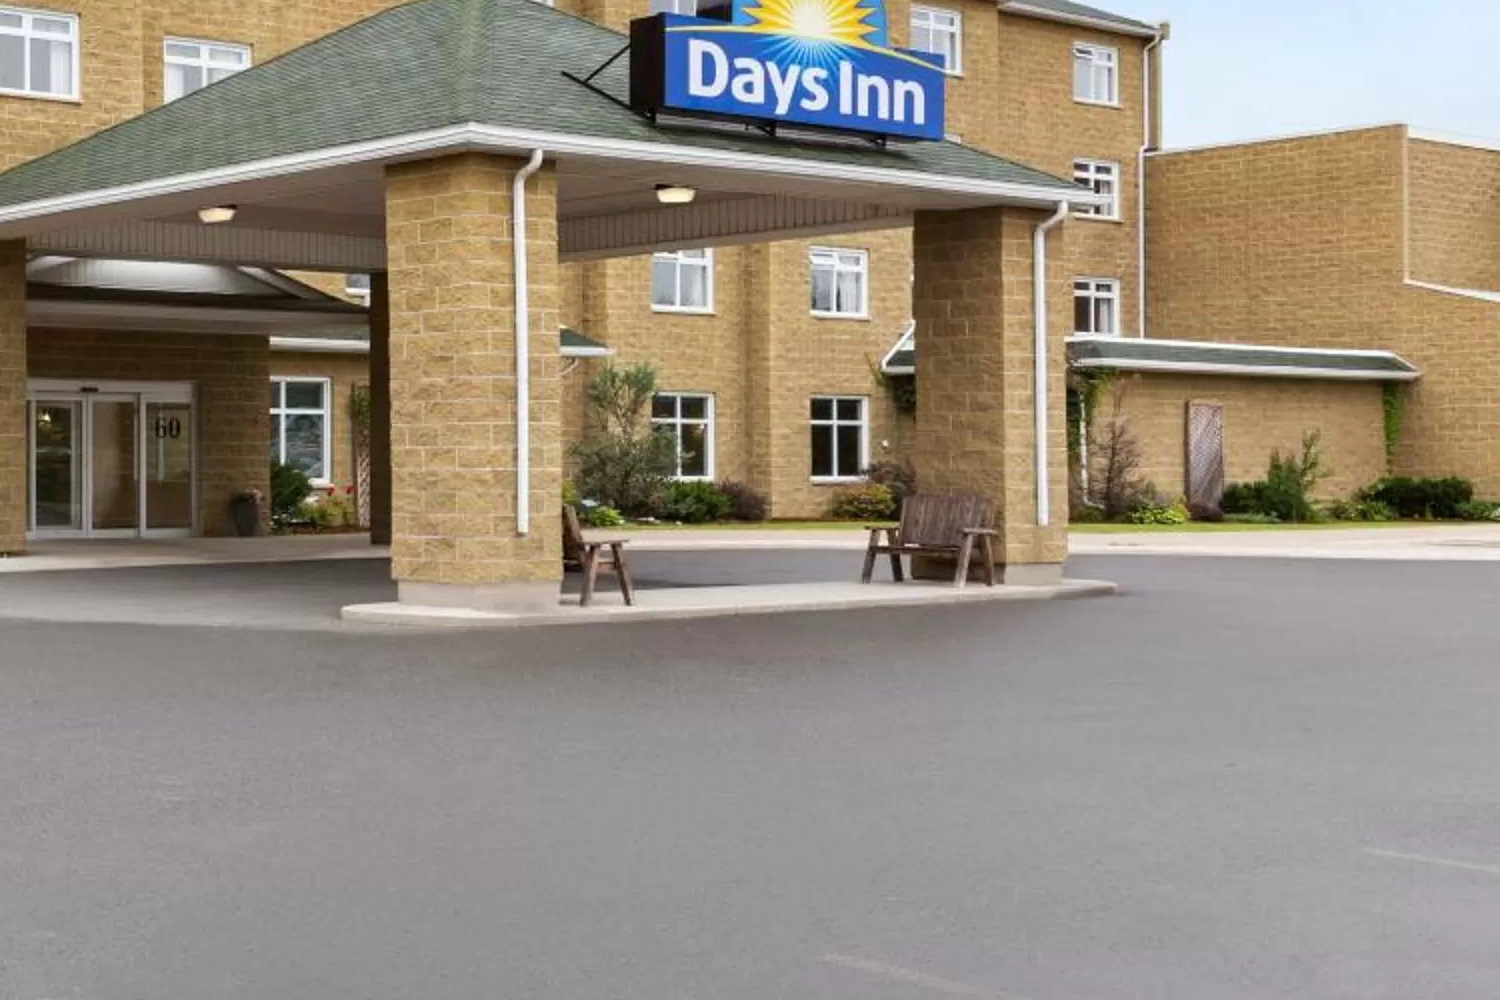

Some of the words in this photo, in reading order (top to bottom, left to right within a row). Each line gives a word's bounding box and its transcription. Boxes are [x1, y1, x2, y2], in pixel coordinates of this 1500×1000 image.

[687, 38, 829, 115] Days
[839, 60, 925, 125] Inn
[155, 416, 181, 439] 60
